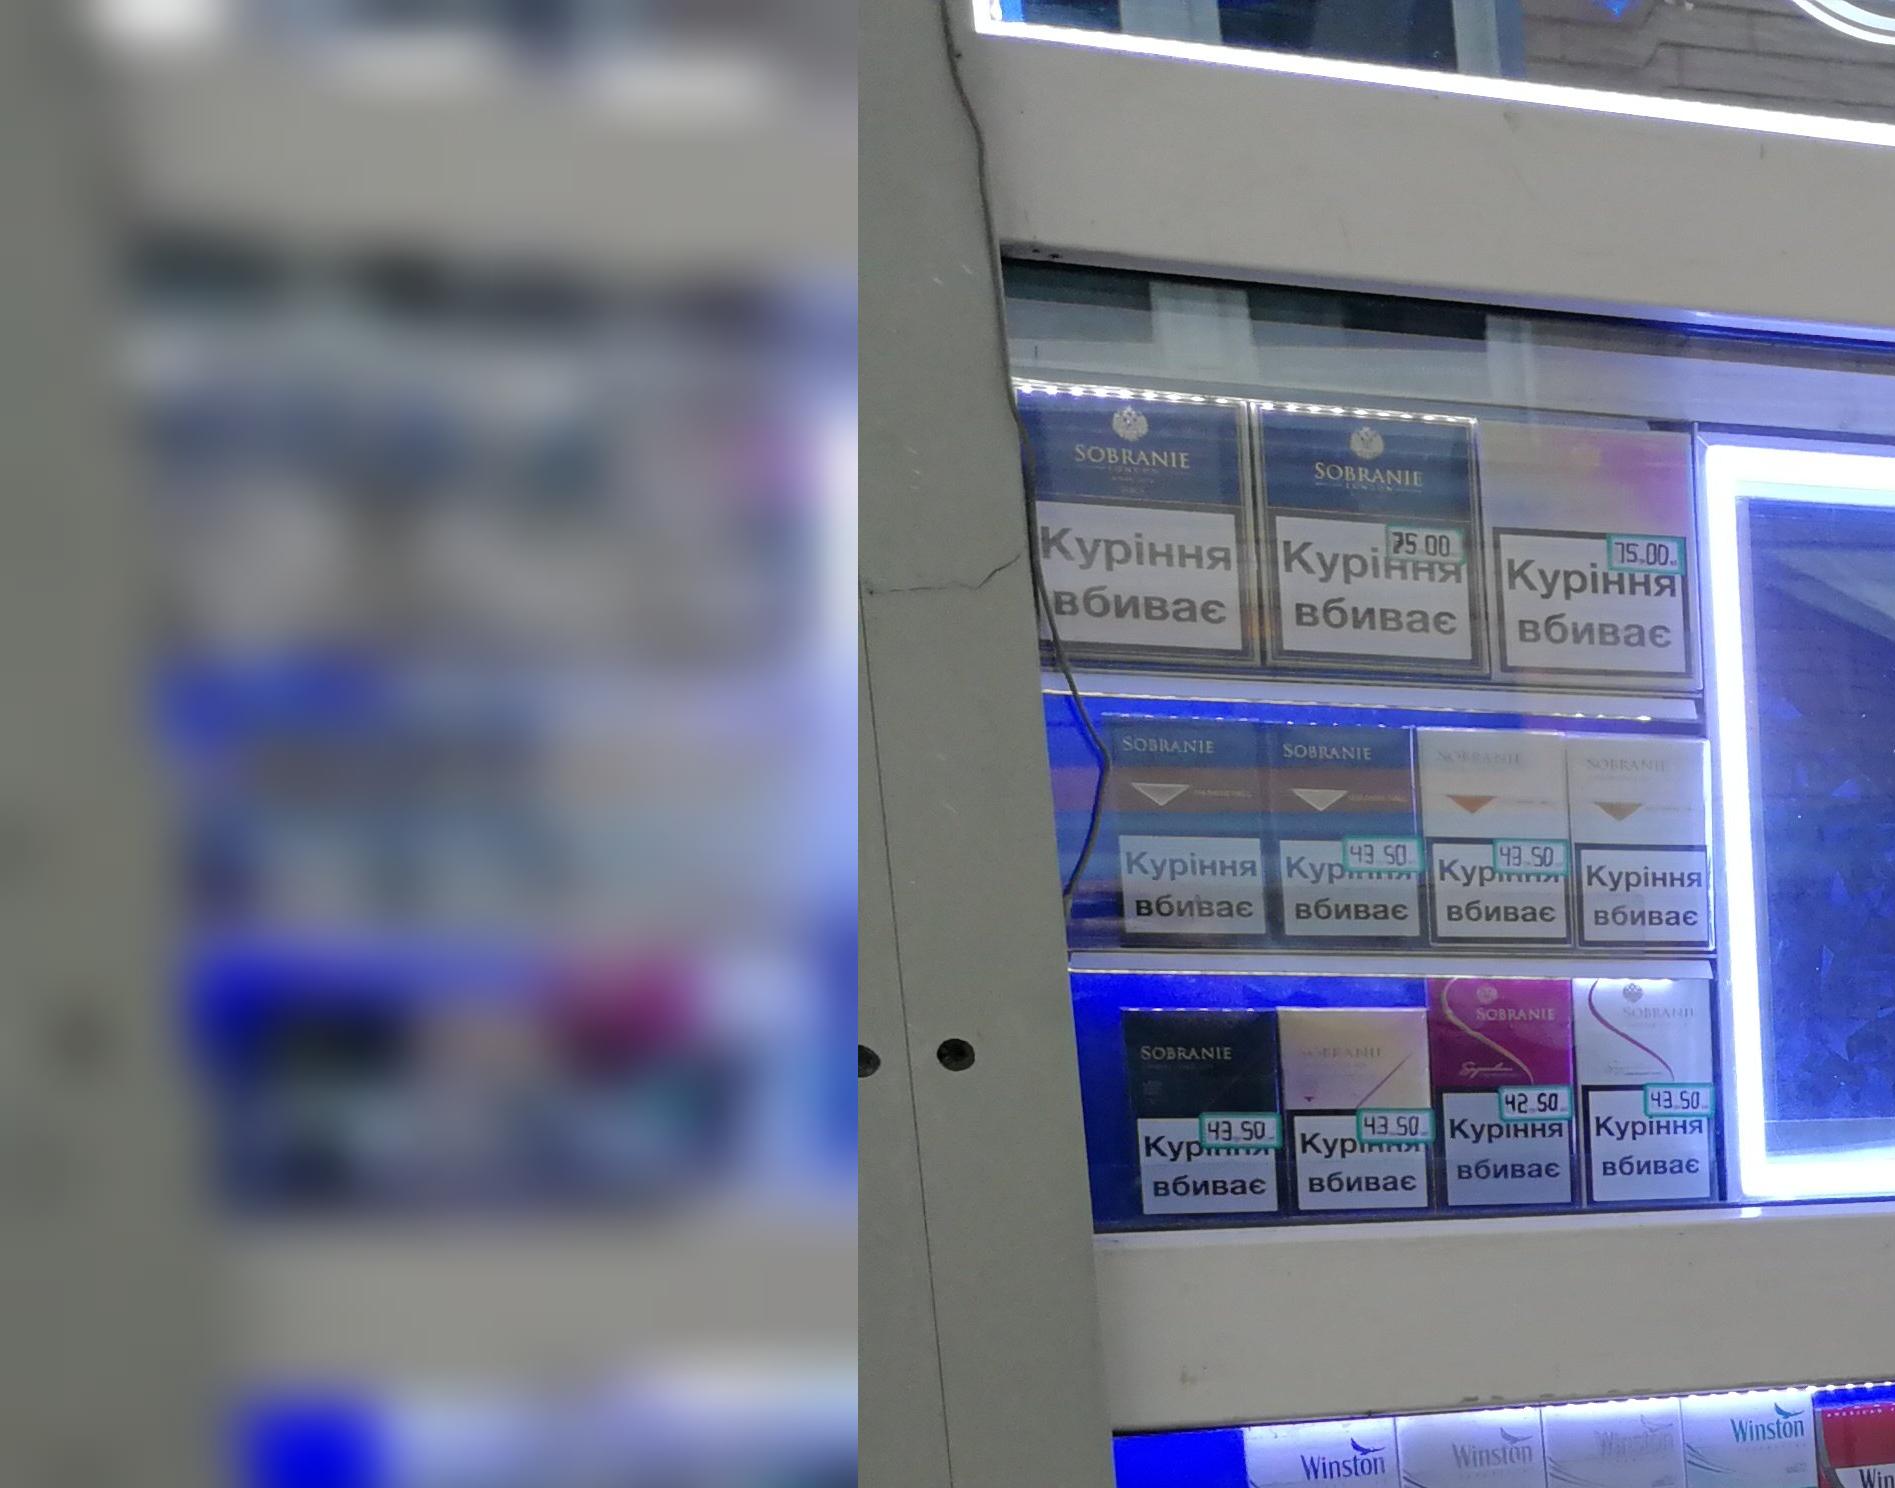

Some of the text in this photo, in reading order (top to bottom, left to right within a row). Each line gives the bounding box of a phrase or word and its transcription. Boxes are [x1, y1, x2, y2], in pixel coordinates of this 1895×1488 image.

[1074, 444, 1191, 472] SOBRANIE
[1314, 460, 1423, 488] SOBRANIE
[1040, 525, 1233, 575] Куріння
[1507, 559, 1678, 600] Куріння
[1053, 586, 1227, 625] вбиває
[1295, 600, 1458, 637] вбиває
[1519, 616, 1673, 650] вбиває
[1122, 735, 1216, 756] SOBRANIE
[1283, 742, 1373, 762] SOBRANIE
[1125, 850, 1258, 882] Куріння
[1586, 863, 1702, 891] Куріння
[1135, 894, 1254, 921] вбиває
[1294, 898, 1409, 923] вбиває
[1446, 899, 1556, 926] вбиває
[1593, 903, 1699, 929] вбиває
[1475, 1006, 1556, 1023] SOBRANIE
[1141, 1043, 1233, 1063] SOBRANIE
[1456, 1155, 1561, 1182] вбиває
[1602, 1151, 1700, 1176] вбиває
[1152, 1175, 1267, 1200] вбиває
[1308, 1169, 1418, 1196] вбиває
[1730, 1415, 1806, 1444] Winston
[1301, 1451, 1387, 1481] Winston
